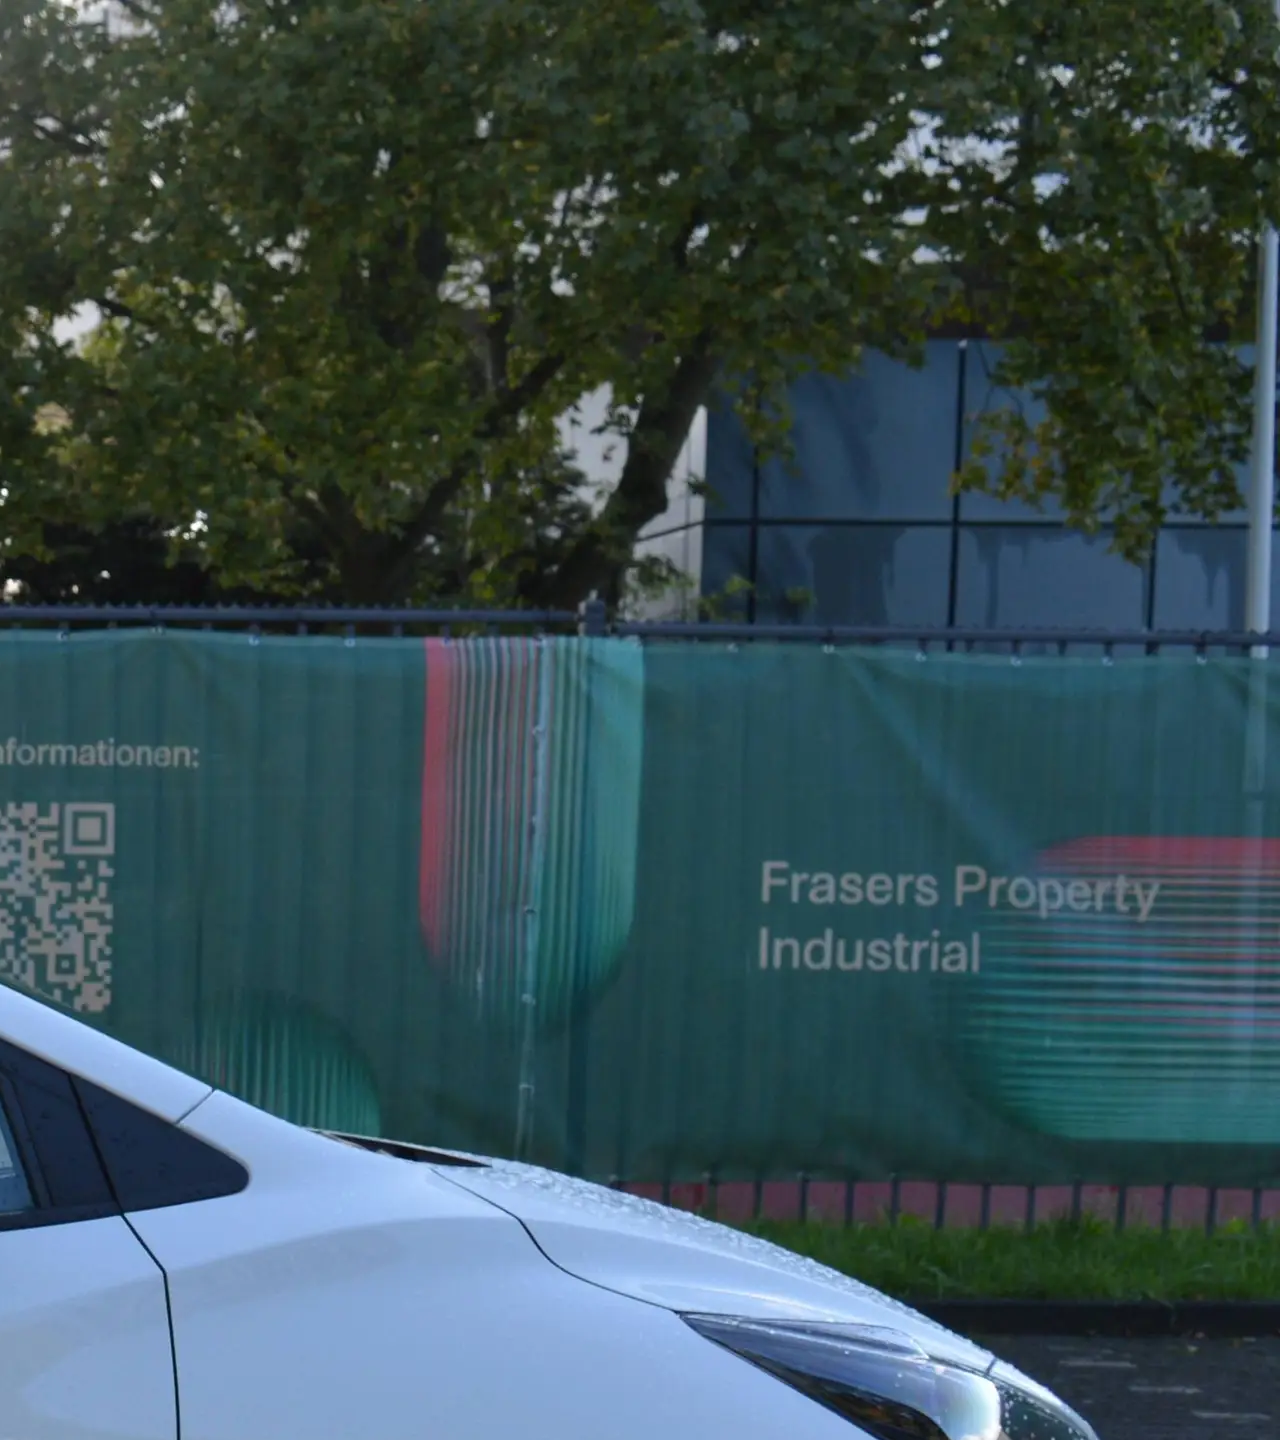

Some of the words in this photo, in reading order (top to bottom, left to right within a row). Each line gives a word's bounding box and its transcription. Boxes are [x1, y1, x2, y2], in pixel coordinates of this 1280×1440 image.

[760, 860, 940, 907] Frasers
[954, 865, 1162, 923] Property
[757, 927, 981, 973] Industrial
